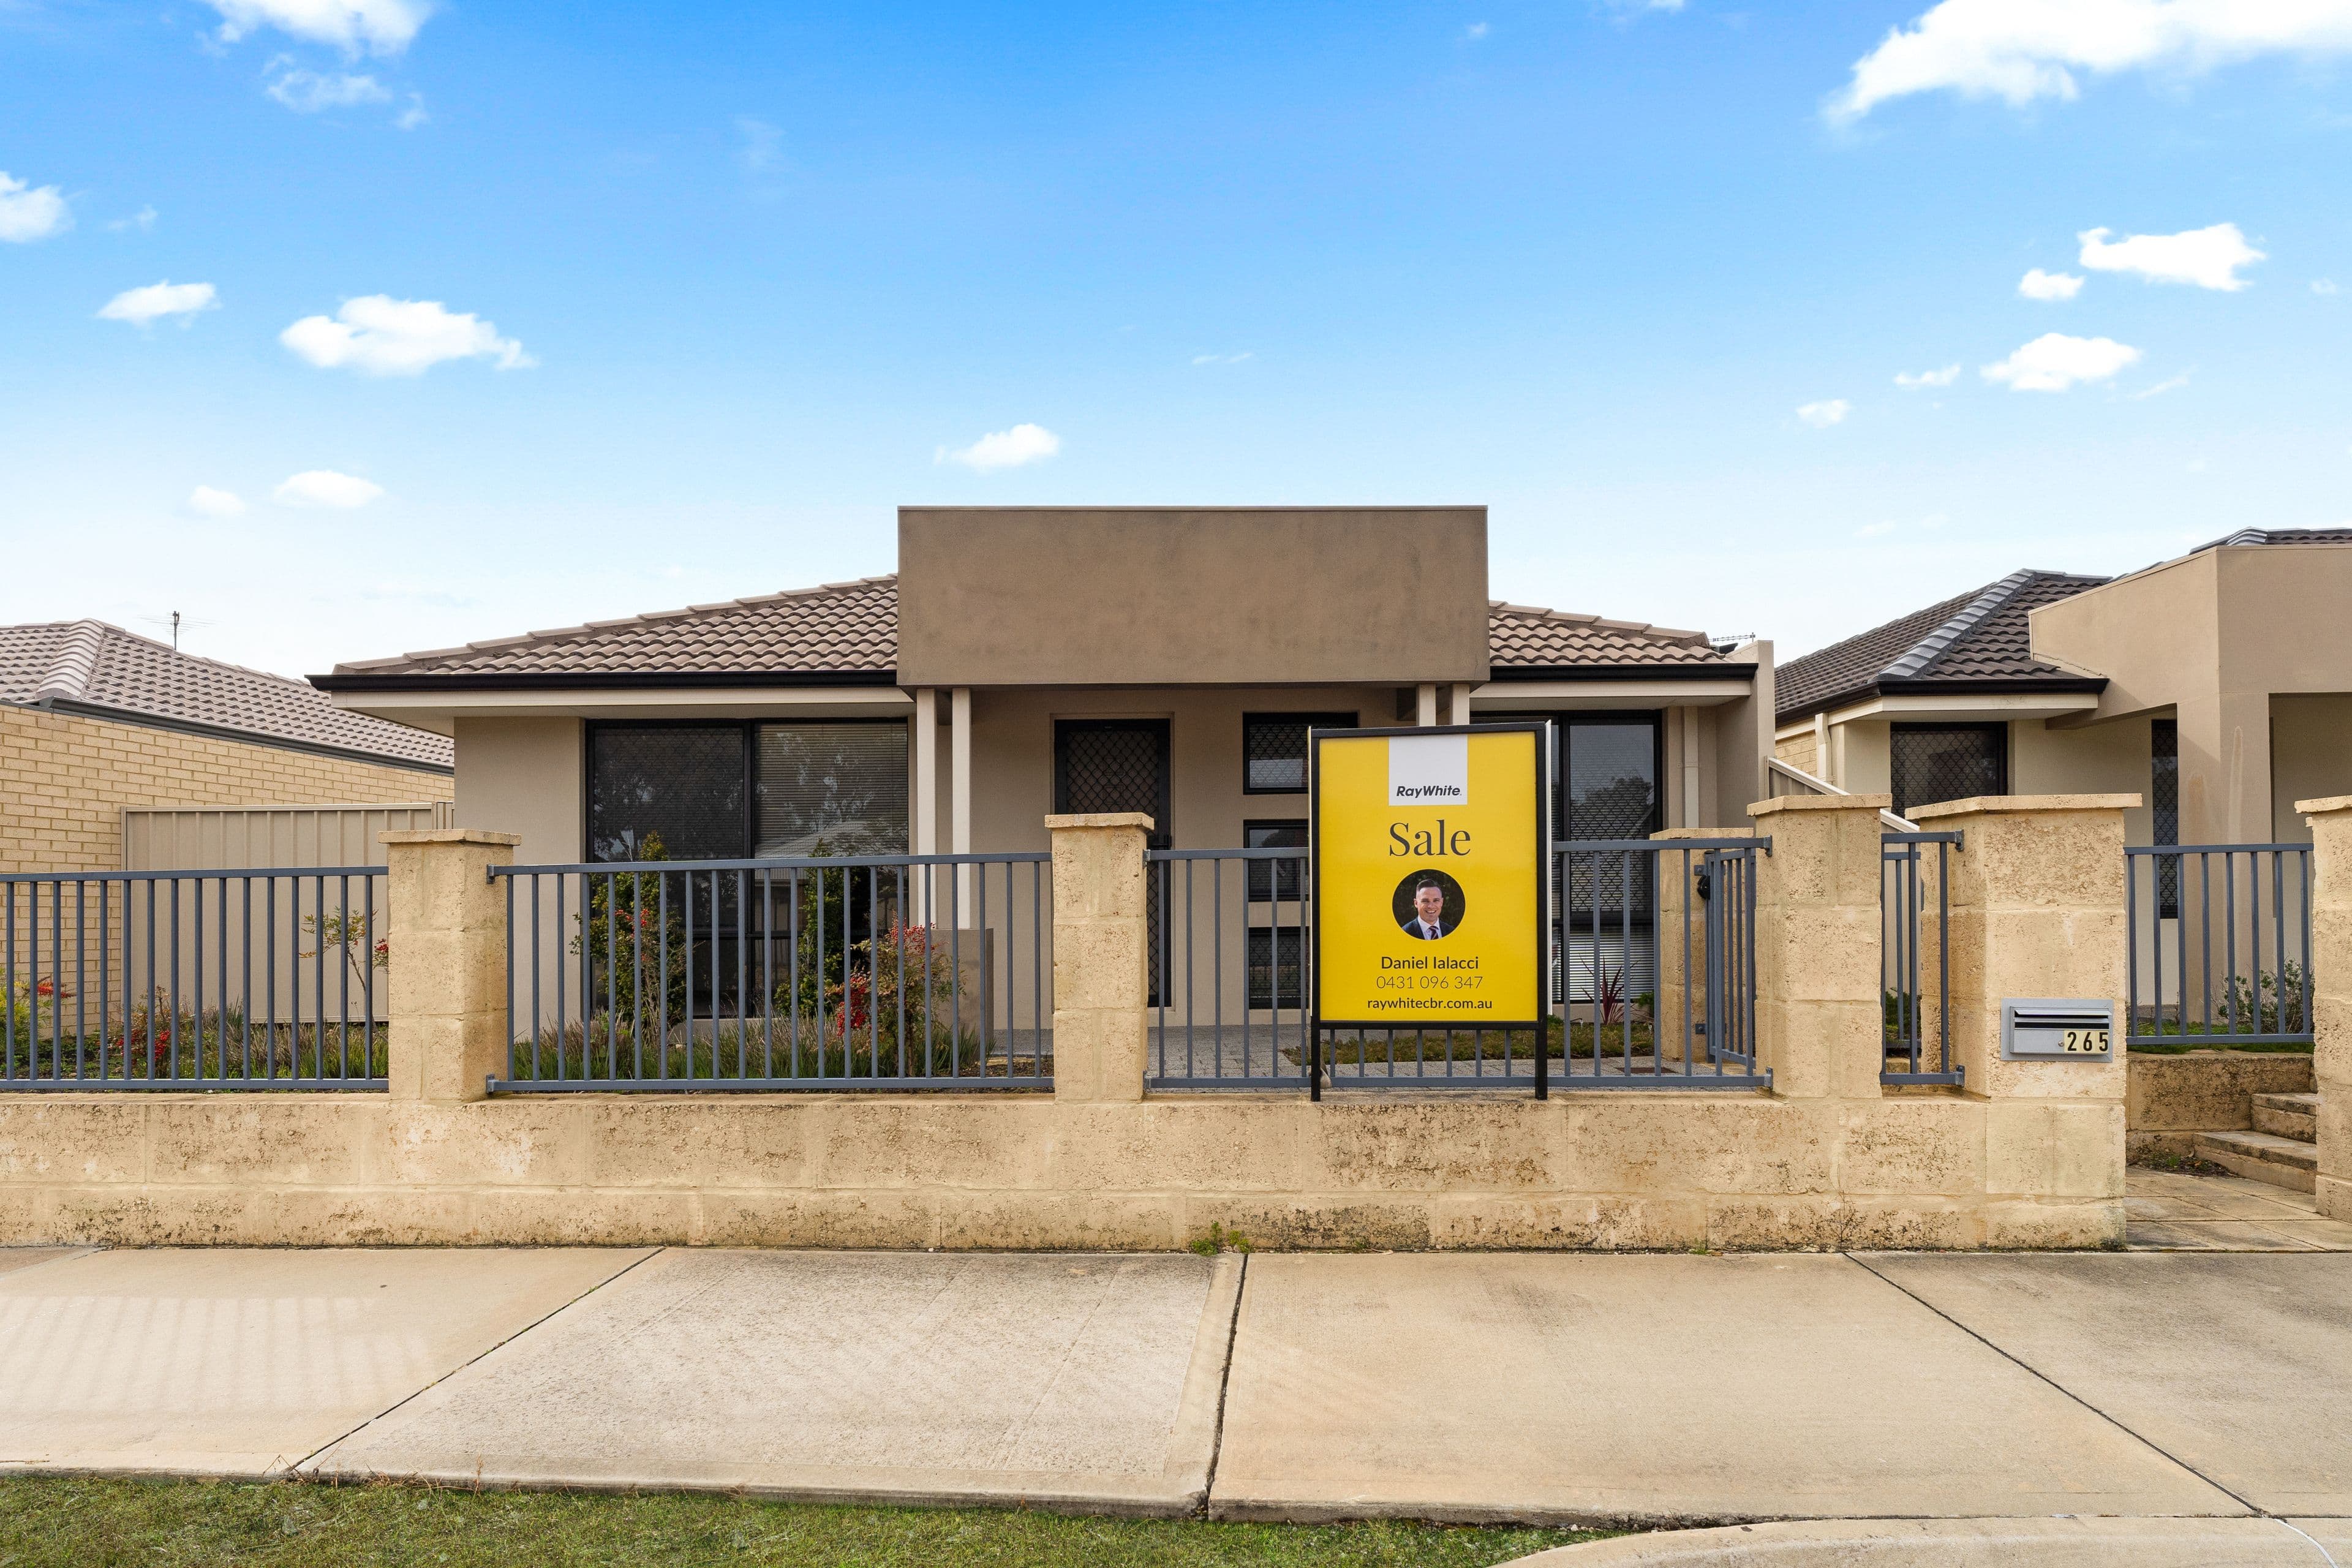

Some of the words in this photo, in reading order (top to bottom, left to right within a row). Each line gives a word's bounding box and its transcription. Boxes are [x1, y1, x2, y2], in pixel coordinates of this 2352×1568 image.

[1389, 819, 1471, 856] Sale
[1381, 956, 1428, 969] Daniel
[1433, 956, 1479, 969] Ialacci
[1376, 976, 1414, 989] 0431
[1420, 976, 1449, 989] 096
[1454, 976, 1483, 989] 347
[1367, 997, 1492, 1011] raywhitecbr.com.au
[2067, 1031, 2108, 1052] 265
